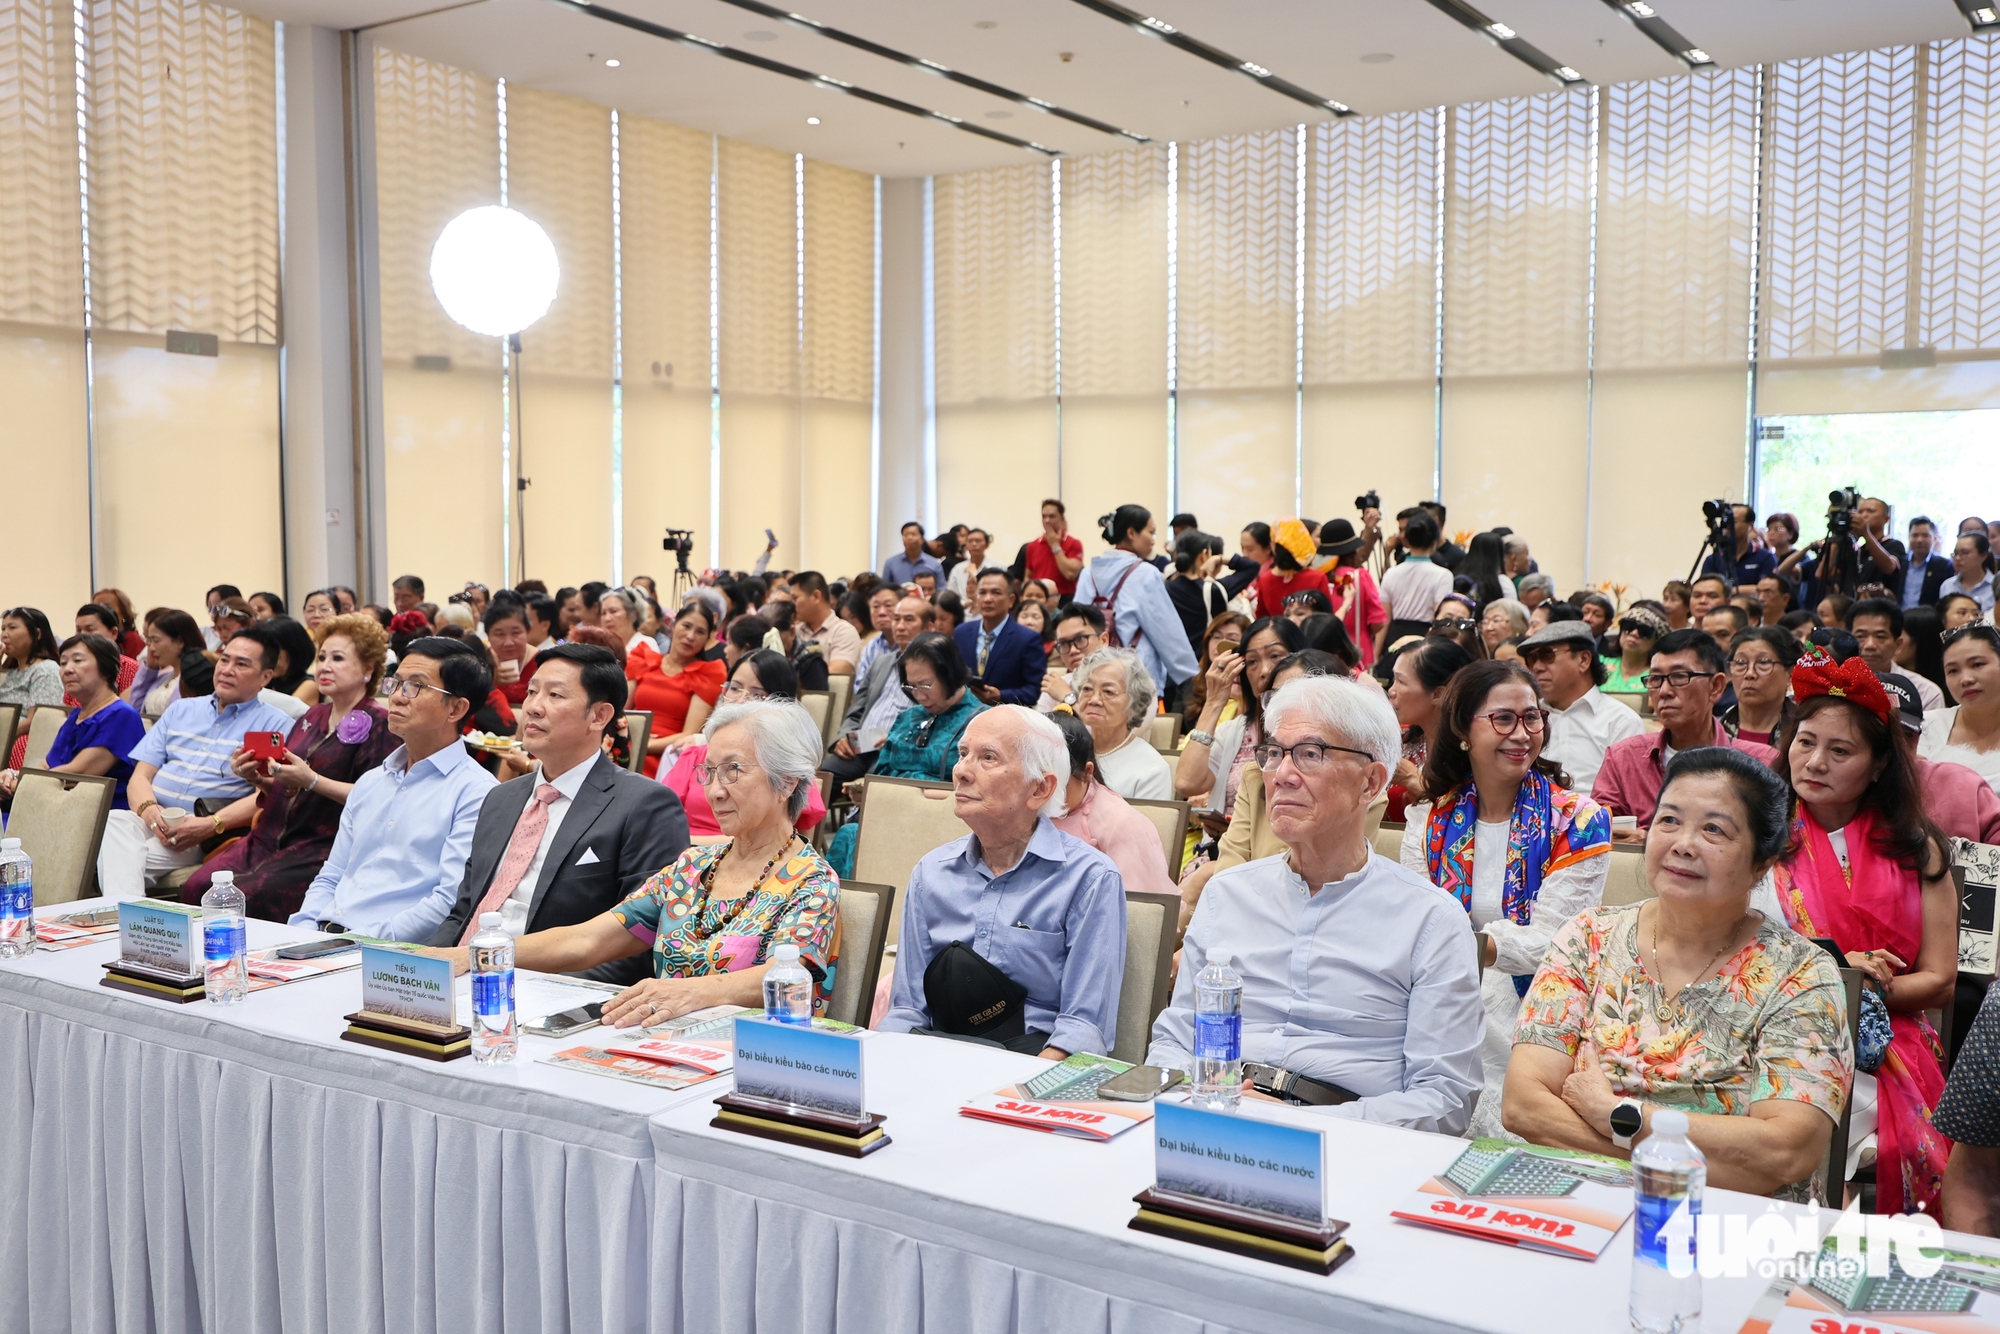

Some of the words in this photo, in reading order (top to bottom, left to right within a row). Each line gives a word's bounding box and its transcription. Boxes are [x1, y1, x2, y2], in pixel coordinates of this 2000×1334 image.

[129, 922, 142, 932] LÂM
[143, 925, 166, 937] QUANG
[167, 930, 180, 939] QUÝ
[144, 916, 157, 924] LUẬT
[395, 963, 409, 973] TIẾN
[409, 965, 416, 975] SĨ
[372, 971, 399, 984] LƯƠNG
[400, 977, 422, 989] BẠCH
[423, 979, 440, 992] VÂN
[968, 1012, 983, 1024] THE
[982, 1000, 1006, 1017] GRAND
[738, 1049, 753, 1061] Đại
[754, 1051, 773, 1064] biểu
[775, 1054, 793, 1068] kiều
[795, 1059, 812, 1071] bào
[814, 1063, 830, 1075] các
[832, 1068, 857, 1080] nước
[1159, 1137, 1177, 1152] Đại
[1180, 1140, 1204, 1156] biểu
[1207, 1146, 1231, 1162] kiều
[1234, 1152, 1256, 1167] bào
[1258, 1158, 1279, 1172] các
[1282, 1165, 1315, 1179] nước
